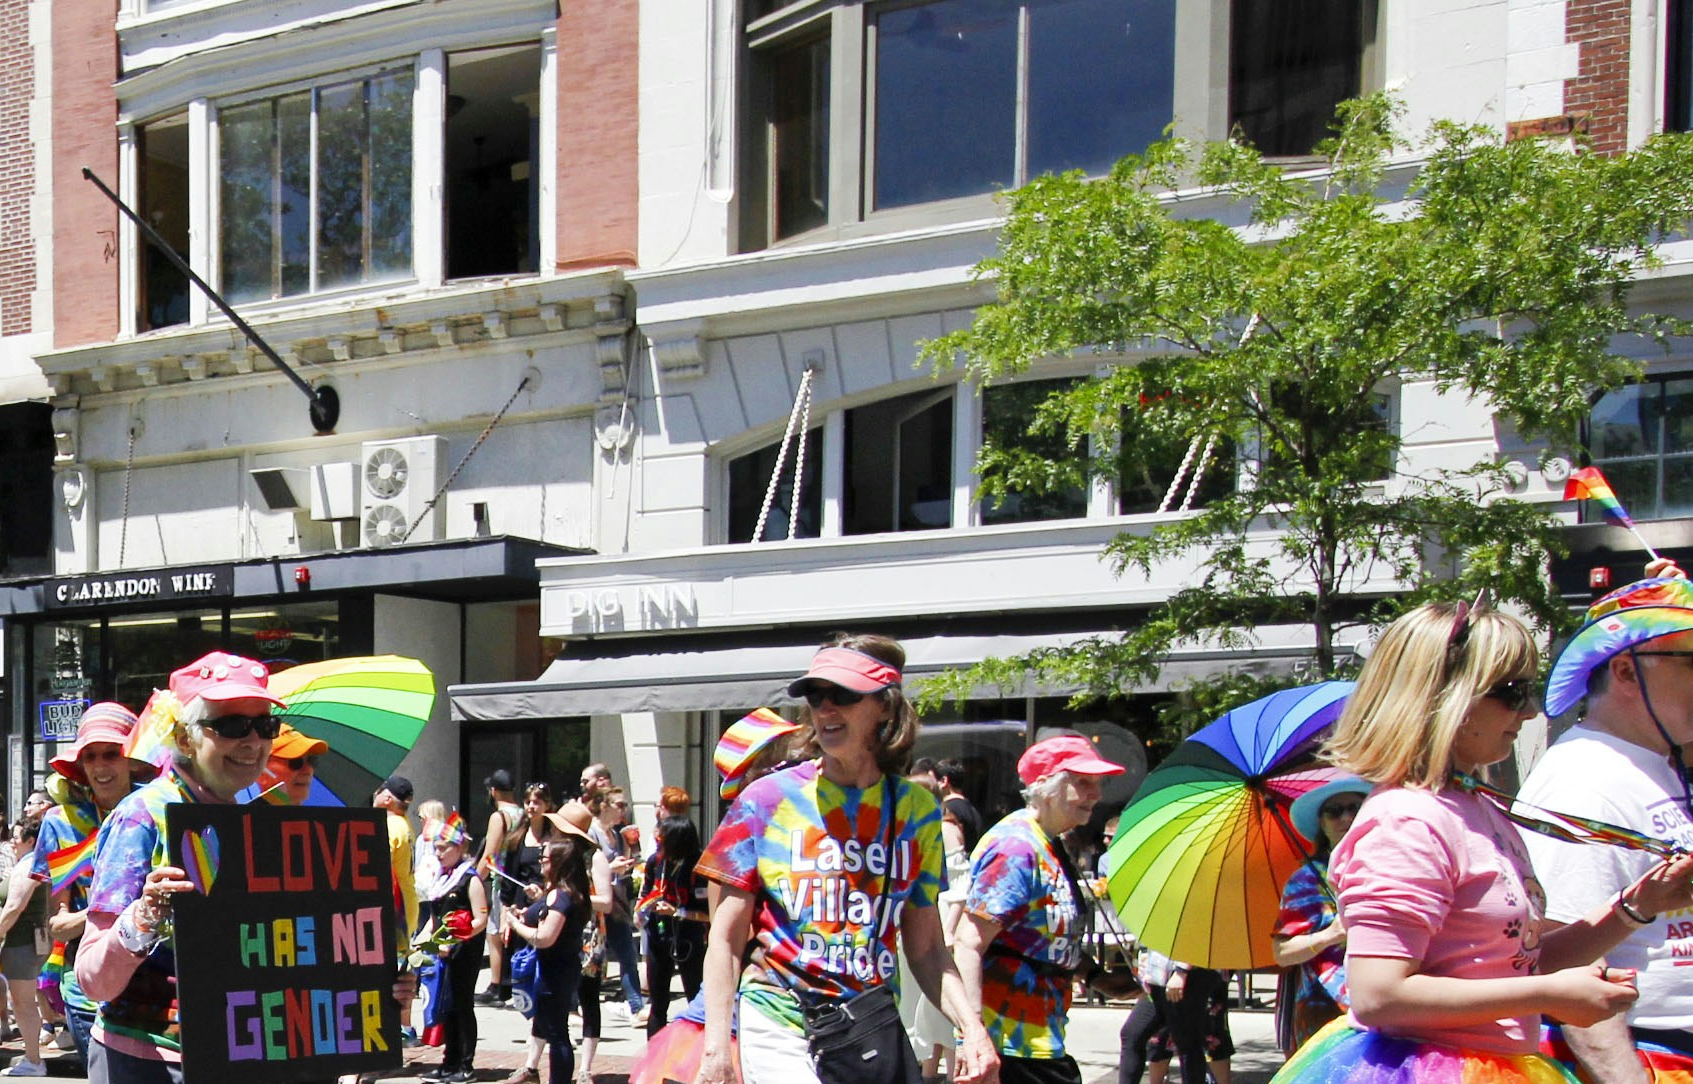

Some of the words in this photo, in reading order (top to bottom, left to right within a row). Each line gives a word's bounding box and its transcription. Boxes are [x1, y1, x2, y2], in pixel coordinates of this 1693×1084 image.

[57, 577, 161, 602] CLARENDON
[171, 572, 217, 593] WINE
[566, 588, 621, 618] DIG
[637, 583, 696, 618] INN
[43, 719, 80, 736] LIGH
[49, 705, 83, 721] BUD
[242, 812, 379, 893] LOVE
[790, 829, 910, 881] Lasell
[240, 916, 318, 968] HAS
[332, 906, 386, 966] NO
[798, 931, 895, 981] Pride
[226, 988, 389, 1062] GENDER
